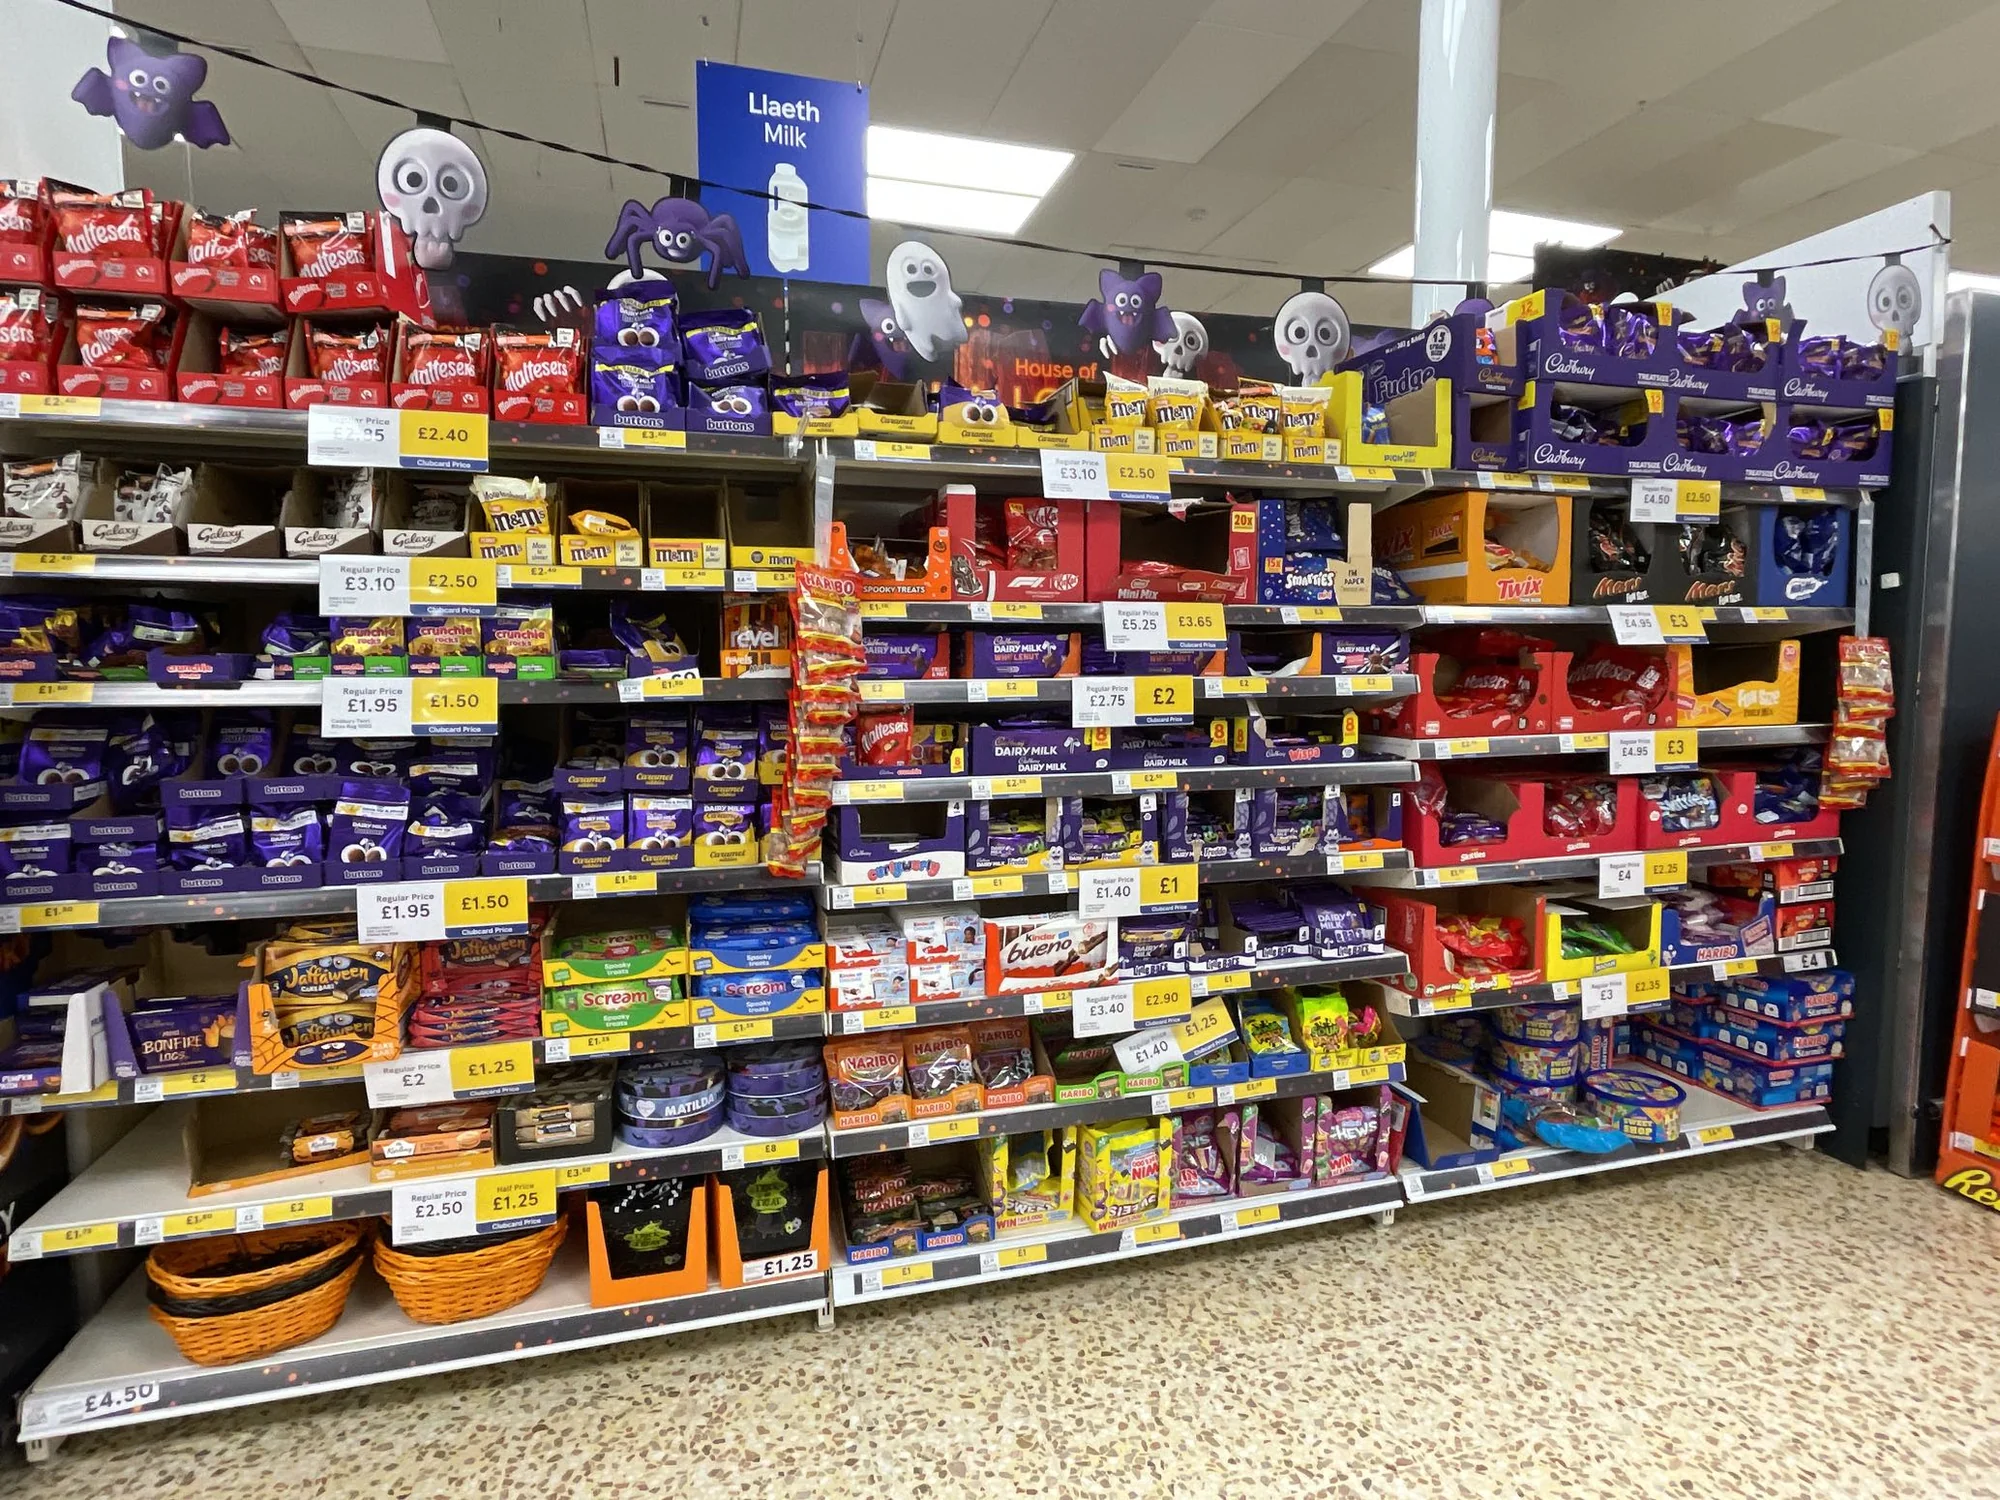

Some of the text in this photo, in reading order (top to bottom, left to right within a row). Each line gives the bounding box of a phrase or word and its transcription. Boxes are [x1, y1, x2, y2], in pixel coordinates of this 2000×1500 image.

[749, 92, 820, 123] Llaeth
[764, 122, 807, 148] Milk
[705, 361, 749, 379] buttons
[1015, 358, 1098, 379] House of
[1545, 353, 1595, 379] Cadbury
[1375, 366, 1435, 403] Fudge
[1668, 368, 1709, 393] Cadbury
[1784, 378, 1828, 401] Cadbury
[614, 414, 664, 427] buttons
[417, 426, 469, 442] £2.40
[1535, 443, 1586, 469] Cadbury
[417, 458, 471, 468] Clubcard Price
[1663, 452, 1707, 476] Cadbury
[1060, 467, 1097, 481] £3.10
[1119, 467, 1155, 480] £2.50
[1774, 461, 1819, 482] Cadbury
[1643, 494, 1669, 505] £4.50
[1685, 492, 1711, 503] £2.50
[1234, 514, 1253, 527] 20x
[93, 523, 141, 540] Galaxy
[294, 530, 339, 546] Galaxy
[392, 532, 437, 548] Galaxy
[340, 565, 401, 575] Regular Price
[345, 577, 395, 592] £3.10
[428, 575, 478, 588] £2.50
[803, 572, 855, 595] HARIBO
[1285, 572, 1336, 588] SMARTIES
[863, 584, 925, 594] SPOOKY TREATS
[1496, 576, 1543, 599] Twix
[1118, 589, 1158, 600] Mini Mix
[427, 606, 481, 615] Clubcard Price
[1117, 610, 1141, 618] Regular
[1122, 618, 1157, 631] £5.25
[1178, 616, 1213, 628] £3.65
[1625, 618, 1652, 628] £4.95
[1670, 614, 1688, 628] £3
[344, 626, 395, 638] crunchie
[420, 625, 473, 636] crunchie
[495, 628, 545, 640] crunchie
[357, 636, 381, 646] rocks
[994, 643, 1043, 653] DAIRY MILK
[725, 654, 753, 665] revels
[343, 687, 377, 697] Regular
[1086, 685, 1129, 693] Regular Price
[430, 694, 479, 708] £1.50
[1090, 694, 1125, 708] £2.75
[1153, 687, 1176, 706] £2
[348, 697, 397, 713] £1.95
[428, 725, 481, 734] Clubcard Price
[1346, 716, 1355, 731] 8
[861, 722, 909, 753] Maltesers
[1214, 723, 1225, 739] 8
[994, 745, 1058, 757] DAIRY MILK
[1622, 746, 1648, 757] £4.95
[1667, 738, 1684, 755] £3
[1288, 746, 1320, 762] Wispa
[1018, 761, 1066, 772] DAIRY MILK
[1144, 758, 1188, 767] DAIRY MILK
[568, 775, 606, 785] Caramel
[636, 772, 674, 782] Caramel
[264, 784, 305, 795] buttons
[499, 859, 536, 870] buttons
[1653, 863, 1678, 875] £2.25
[343, 868, 383, 880] buttons
[1618, 871, 1631, 882] £4
[1092, 877, 1118, 886] Regular
[1160, 877, 1179, 894] £1
[376, 893, 435, 903] Regular Price
[1096, 885, 1131, 899] £1.40
[462, 895, 509, 910] £1.50
[381, 903, 431, 919] £1.95
[1317, 913, 1345, 923] DAIRY
[461, 926, 513, 935] Clubcard Price
[1025, 933, 1056, 942] kinder
[1007, 937, 1073, 964] bueno
[1697, 945, 1738, 961] HARIBO
[1801, 954, 1819, 970] £4
[285, 966, 369, 989] Jaffaween
[1634, 980, 1661, 992] £2.35
[582, 989, 648, 1007] Scream
[1086, 993, 1127, 1004] Regular Price
[1145, 992, 1179, 1006] £2.90
[1600, 988, 1614, 1001] £3
[1805, 993, 1838, 1008] HARIBO
[1089, 1002, 1125, 1016] £3.40
[1184, 1014, 1218, 1037] £1.25
[142, 1033, 202, 1053] BONFIRE
[914, 1037, 966, 1054] HARIBO
[1135, 1041, 1169, 1063] £1.40
[846, 1052, 898, 1070] HARIBO
[383, 1062, 441, 1075] Regular Price
[468, 1060, 515, 1076] £1.25
[192, 1074, 207, 1084] £2
[402, 1073, 426, 1088] £2
[1060, 1087, 1094, 1100] HARIBO
[665, 1094, 715, 1117] MATILDA
[915, 1101, 953, 1114] HARIBO
[840, 1113, 879, 1127] HARIBO
[949, 1122, 959, 1131] £1
[765, 1143, 777, 1153] £8
[496, 1182, 535, 1193] Half Price
[411, 1190, 467, 1202] Regular Price
[493, 1193, 539, 1211] £1.25
[290, 1202, 304, 1212] £2
[415, 1201, 463, 1218] £2.50
[491, 1217, 542, 1229] Clubcard Price
[997, 1217, 1017, 1230] WIN
[1098, 1219, 1117, 1230] WIN
[927, 1233, 964, 1248] HARIBO
[852, 1246, 889, 1261] HARIBO
[1018, 1249, 1026, 1257] £1
[764, 1253, 814, 1276] £1.25
[902, 1267, 911, 1276] £1
[84, 1383, 154, 1413] £4.50
